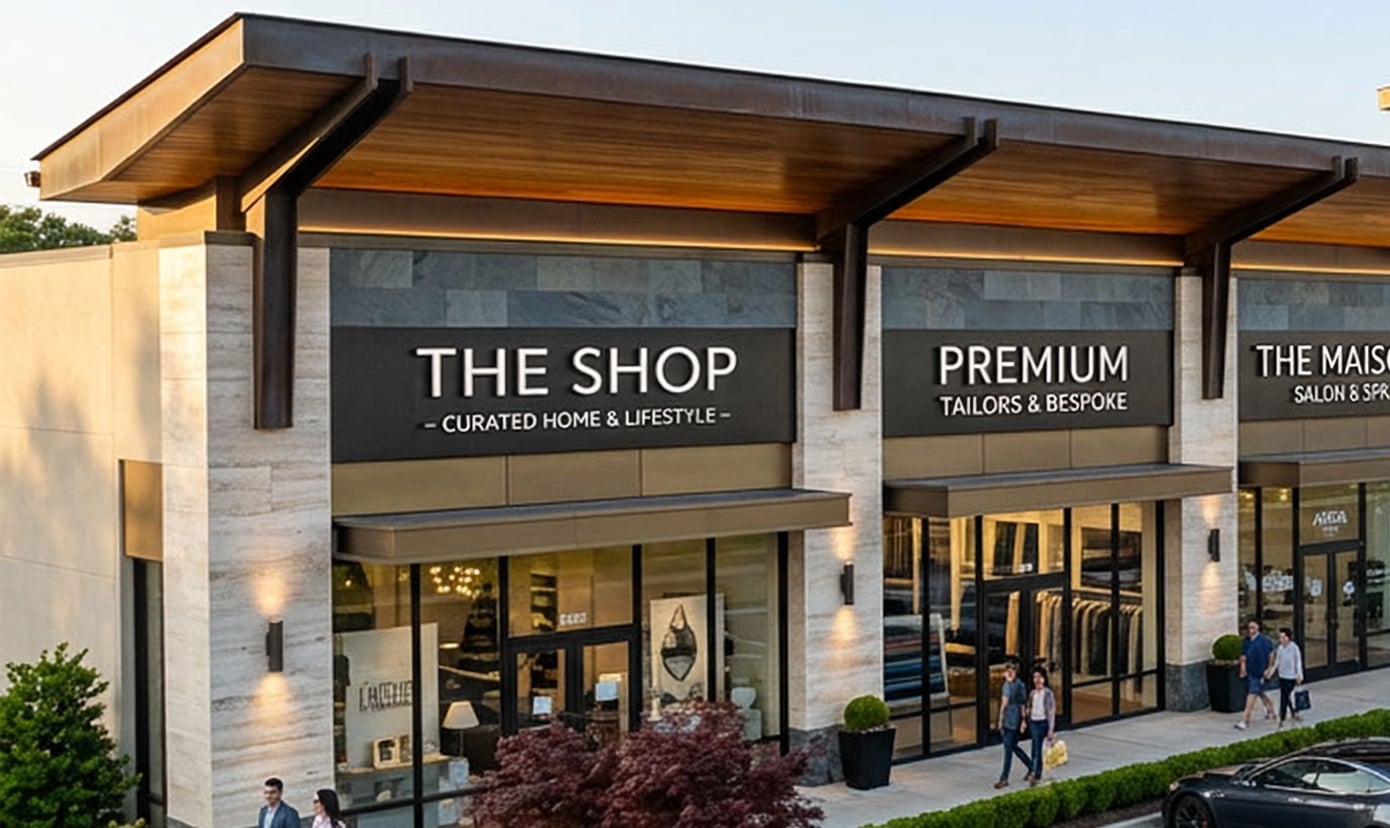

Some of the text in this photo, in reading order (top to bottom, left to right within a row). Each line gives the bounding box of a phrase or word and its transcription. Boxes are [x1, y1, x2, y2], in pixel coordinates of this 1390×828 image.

[416, 346, 737, 397] THE SHOP
[939, 345, 1128, 385] PREMIUM
[1256, 345, 1312, 377] THE
[940, 392, 1128, 416] TAILORS & BESPOKE
[1294, 384, 1345, 404] SALON
[442, 412, 537, 434] CURATED
[543, 410, 601, 430] HOME
[606, 412, 620, 427] &
[625, 407, 716, 427] LIFESTYLE
